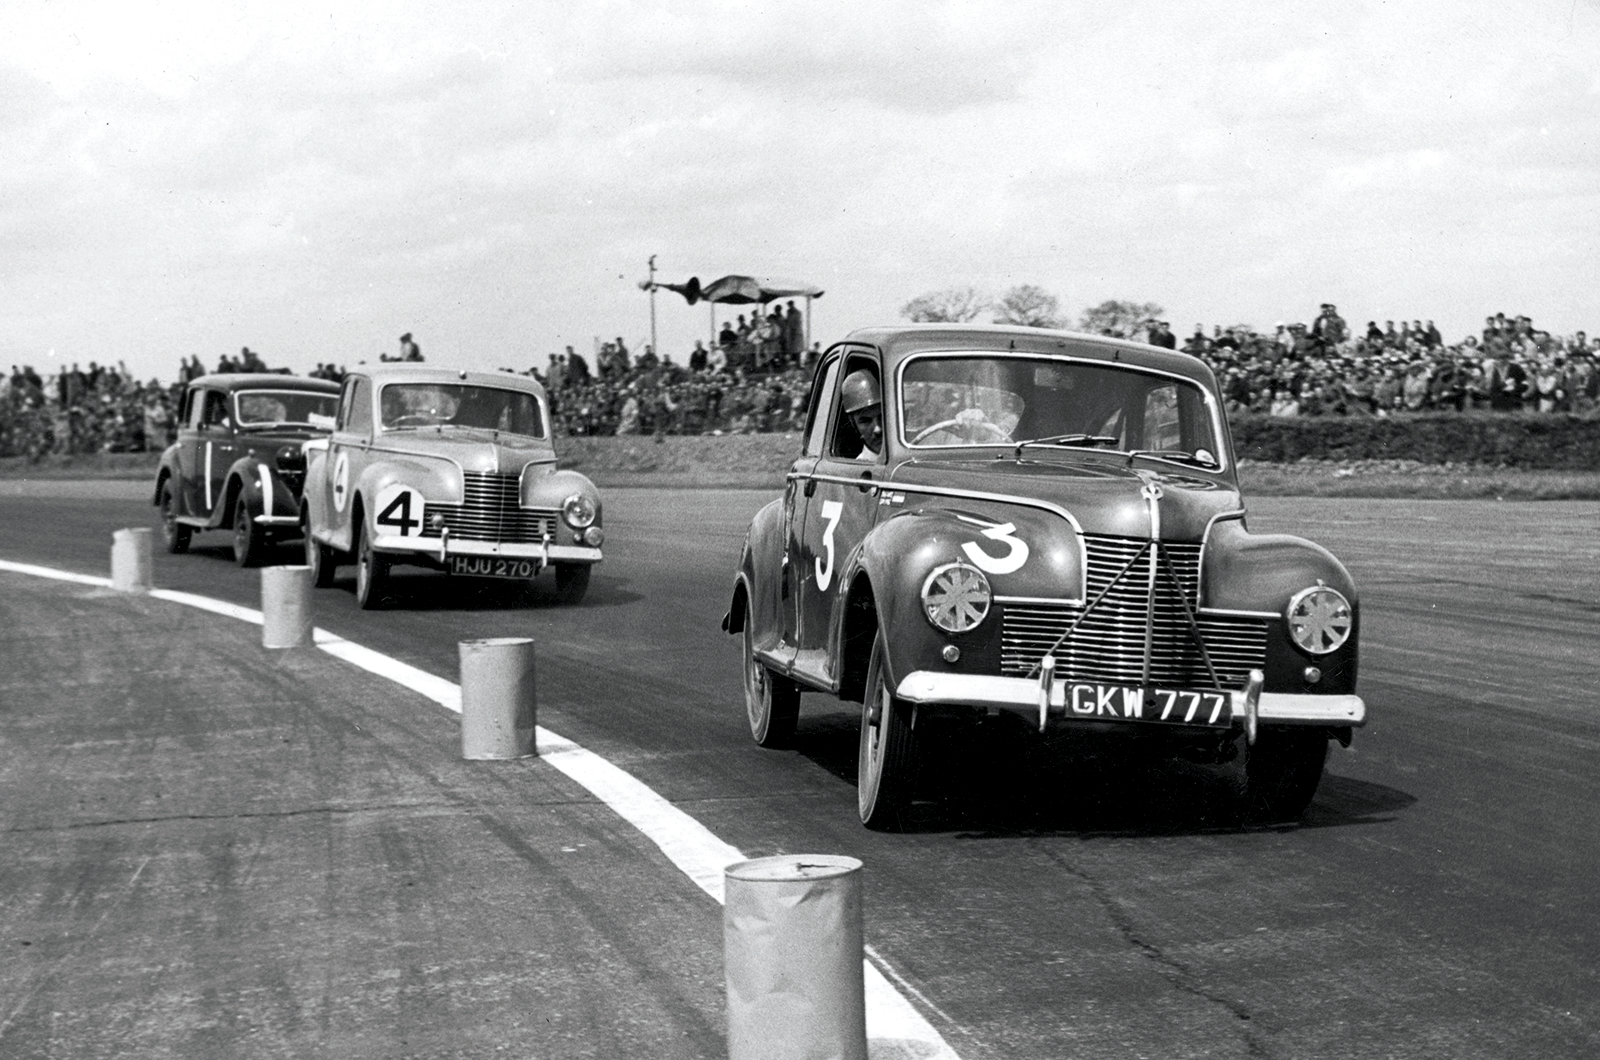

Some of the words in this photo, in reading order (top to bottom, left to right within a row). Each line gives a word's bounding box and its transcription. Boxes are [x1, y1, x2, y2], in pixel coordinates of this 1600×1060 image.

[376, 490, 420, 537] 4
[455, 557, 492, 575] HJU
[495, 560, 531, 577] 270
[815, 500, 843, 592] 3
[956, 514, 1030, 575] 3
[1072, 684, 1144, 718] GKW
[1154, 688, 1225, 724] 777
